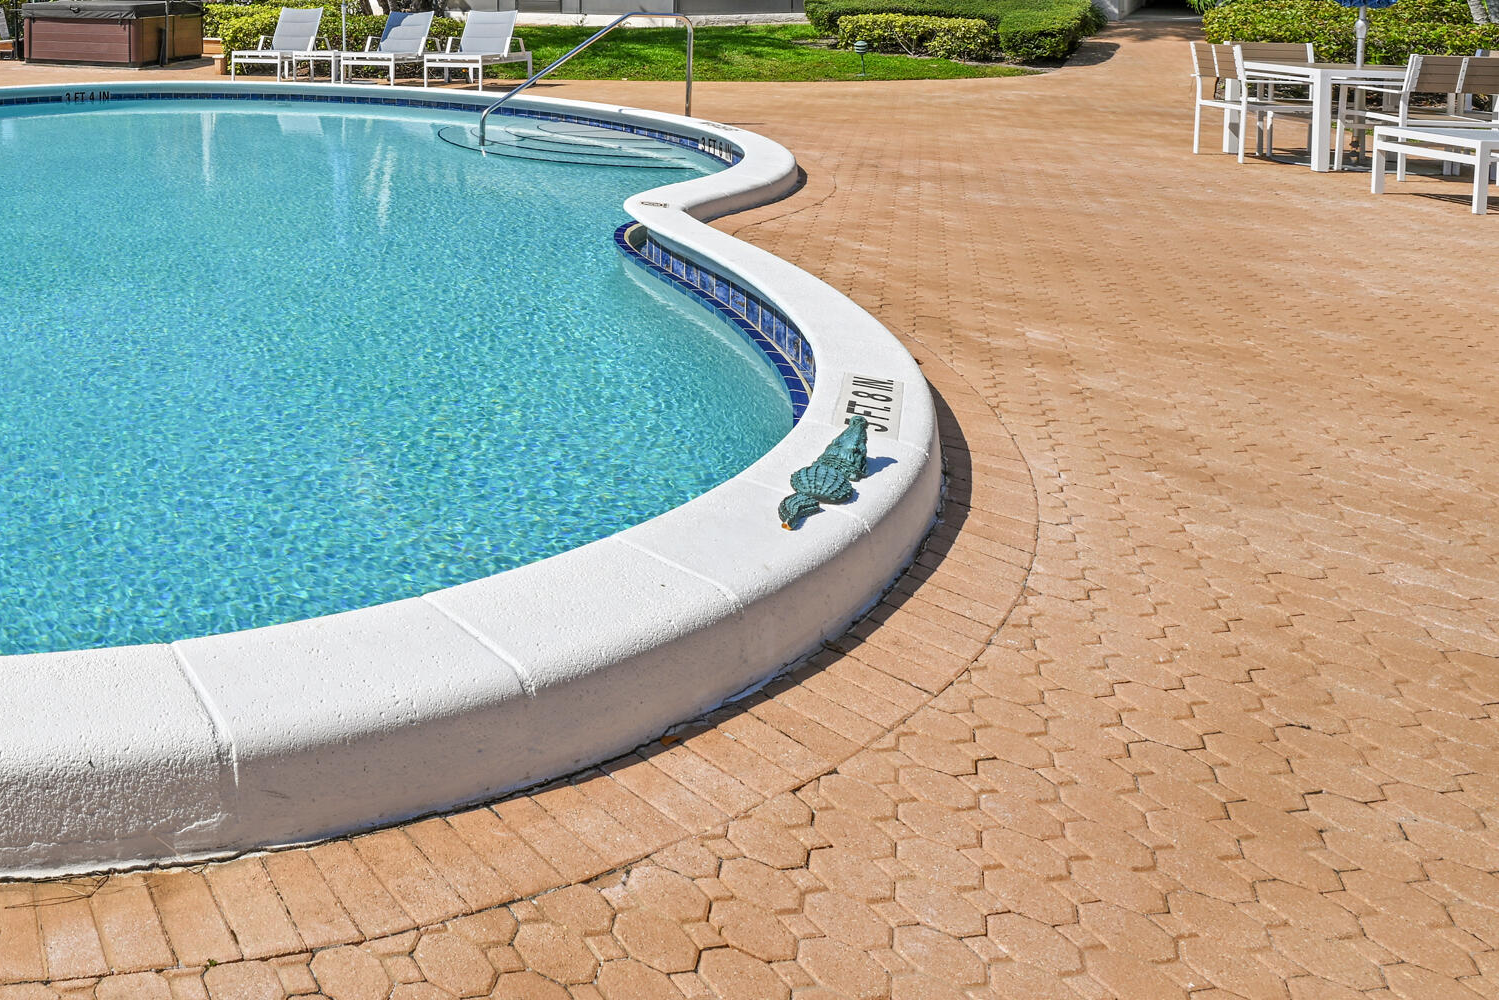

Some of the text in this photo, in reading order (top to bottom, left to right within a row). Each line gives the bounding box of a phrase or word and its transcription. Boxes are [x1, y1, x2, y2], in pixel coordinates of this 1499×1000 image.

[74, 91, 86, 102] FT
[99, 90, 110, 101] IN
[708, 138, 717, 155] FT
[851, 390, 893, 402] 8
